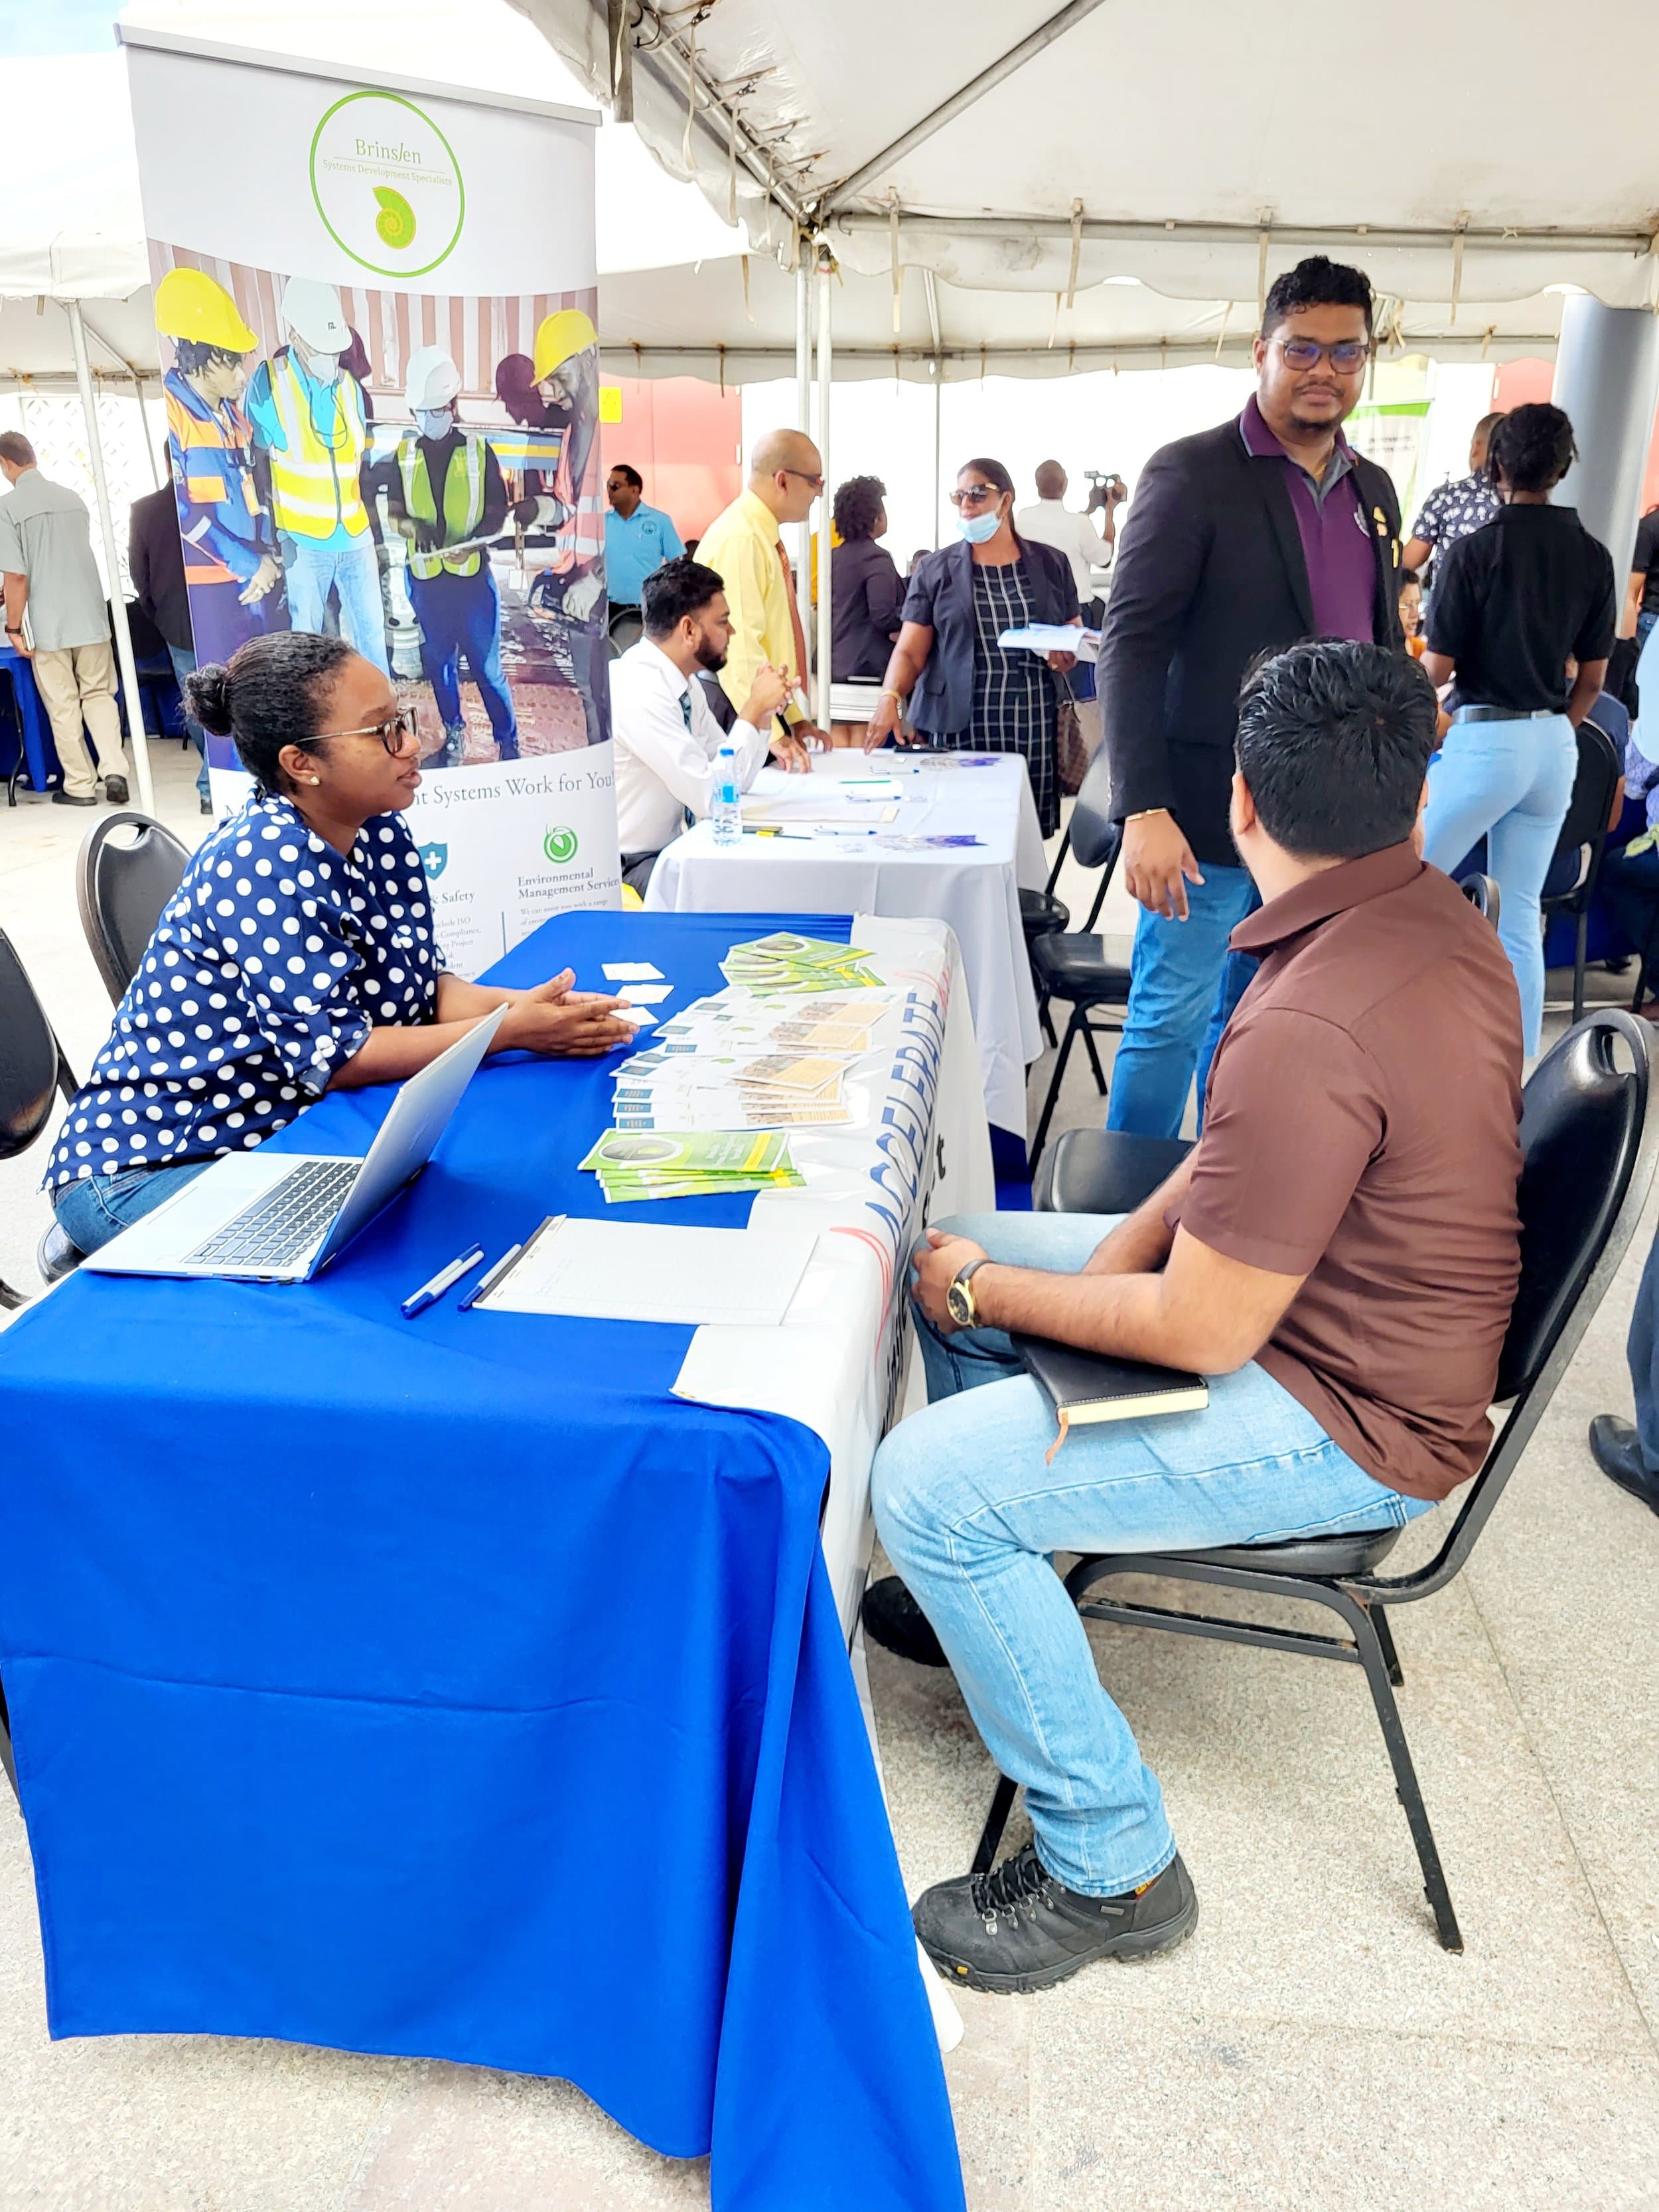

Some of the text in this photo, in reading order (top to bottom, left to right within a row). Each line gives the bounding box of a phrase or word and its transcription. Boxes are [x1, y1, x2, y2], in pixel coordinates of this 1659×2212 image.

[323, 160, 453, 186] Systems Development Specialists
[434, 785, 500, 808] Systems
[505, 775, 553, 796] Work
[559, 773, 582, 792] for
[518, 867, 594, 887] Environmental
[518, 877, 620, 899] Management Services
[442, 889, 474, 903] Safety
